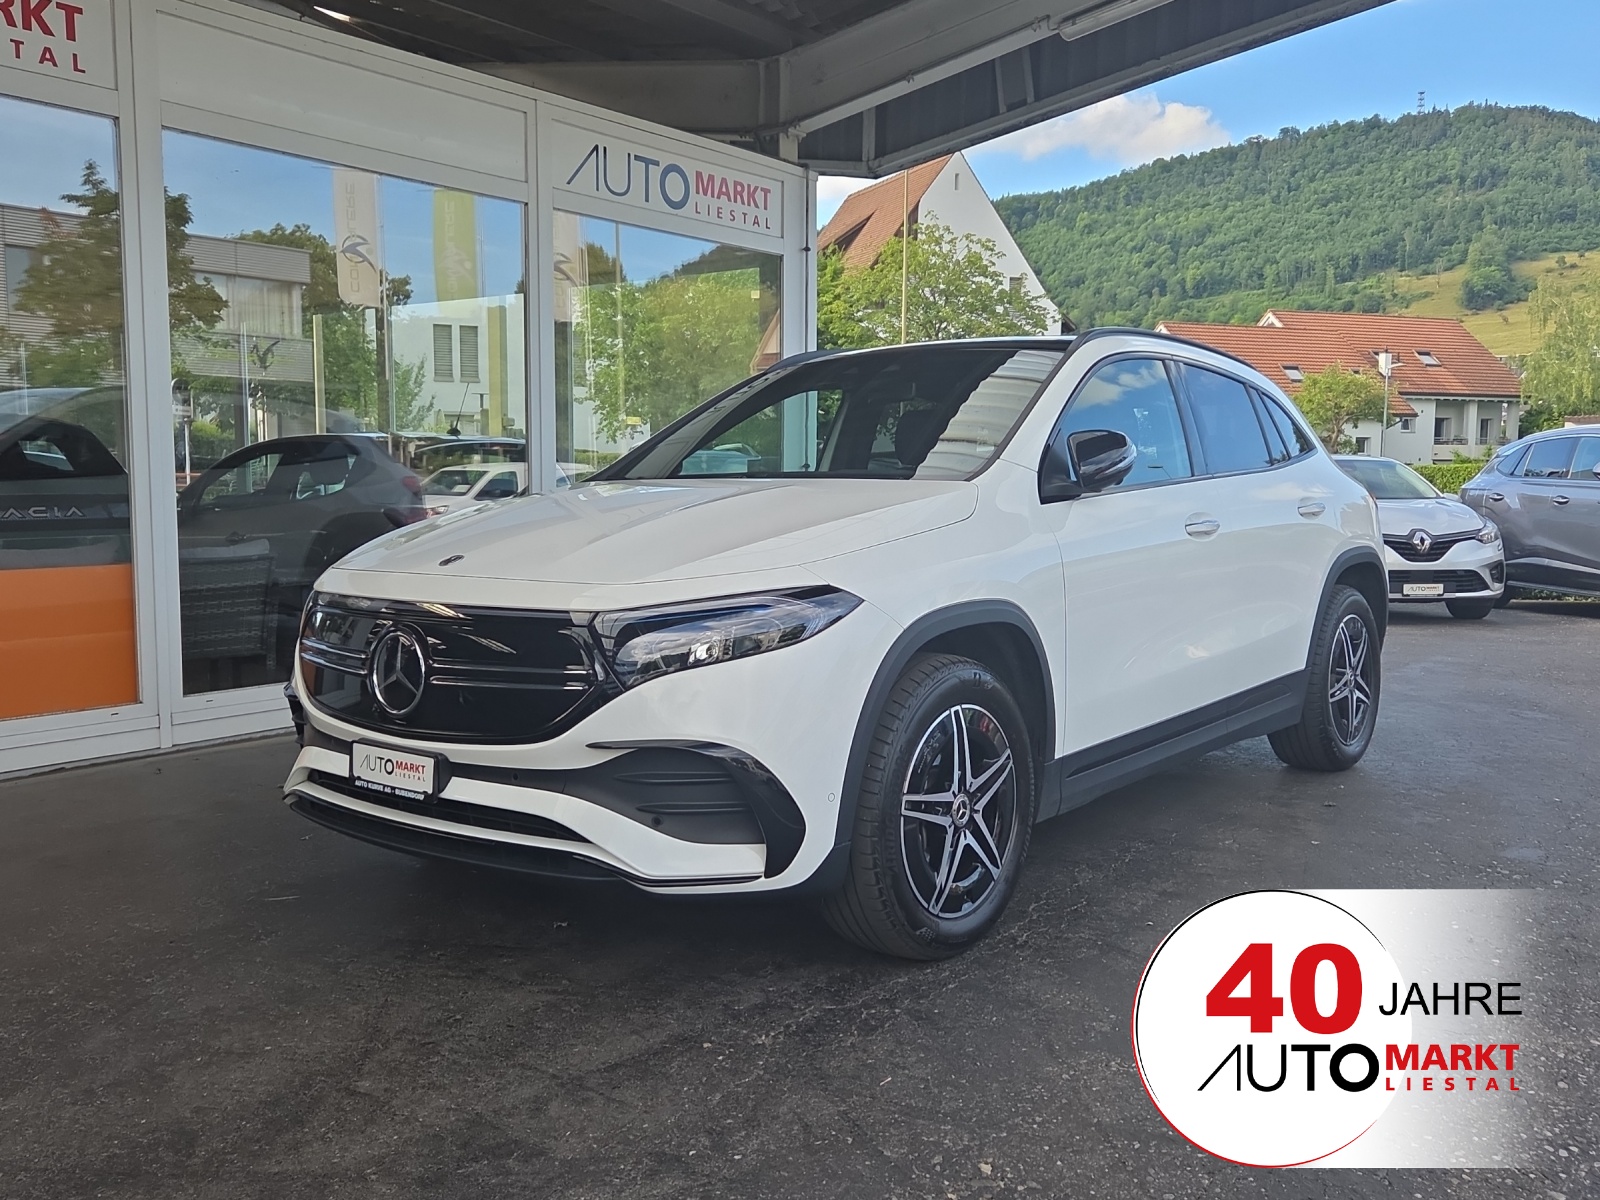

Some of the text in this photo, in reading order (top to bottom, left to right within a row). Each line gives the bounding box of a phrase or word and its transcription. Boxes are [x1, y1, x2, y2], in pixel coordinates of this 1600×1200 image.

[566, 143, 771, 211] AUTO MARKT
[695, 201, 771, 230] LIESTAL
[360, 753, 426, 775] AUTO MARKT
[355, 780, 367, 788] AUTO
[395, 772, 426, 782] LIESTAL
